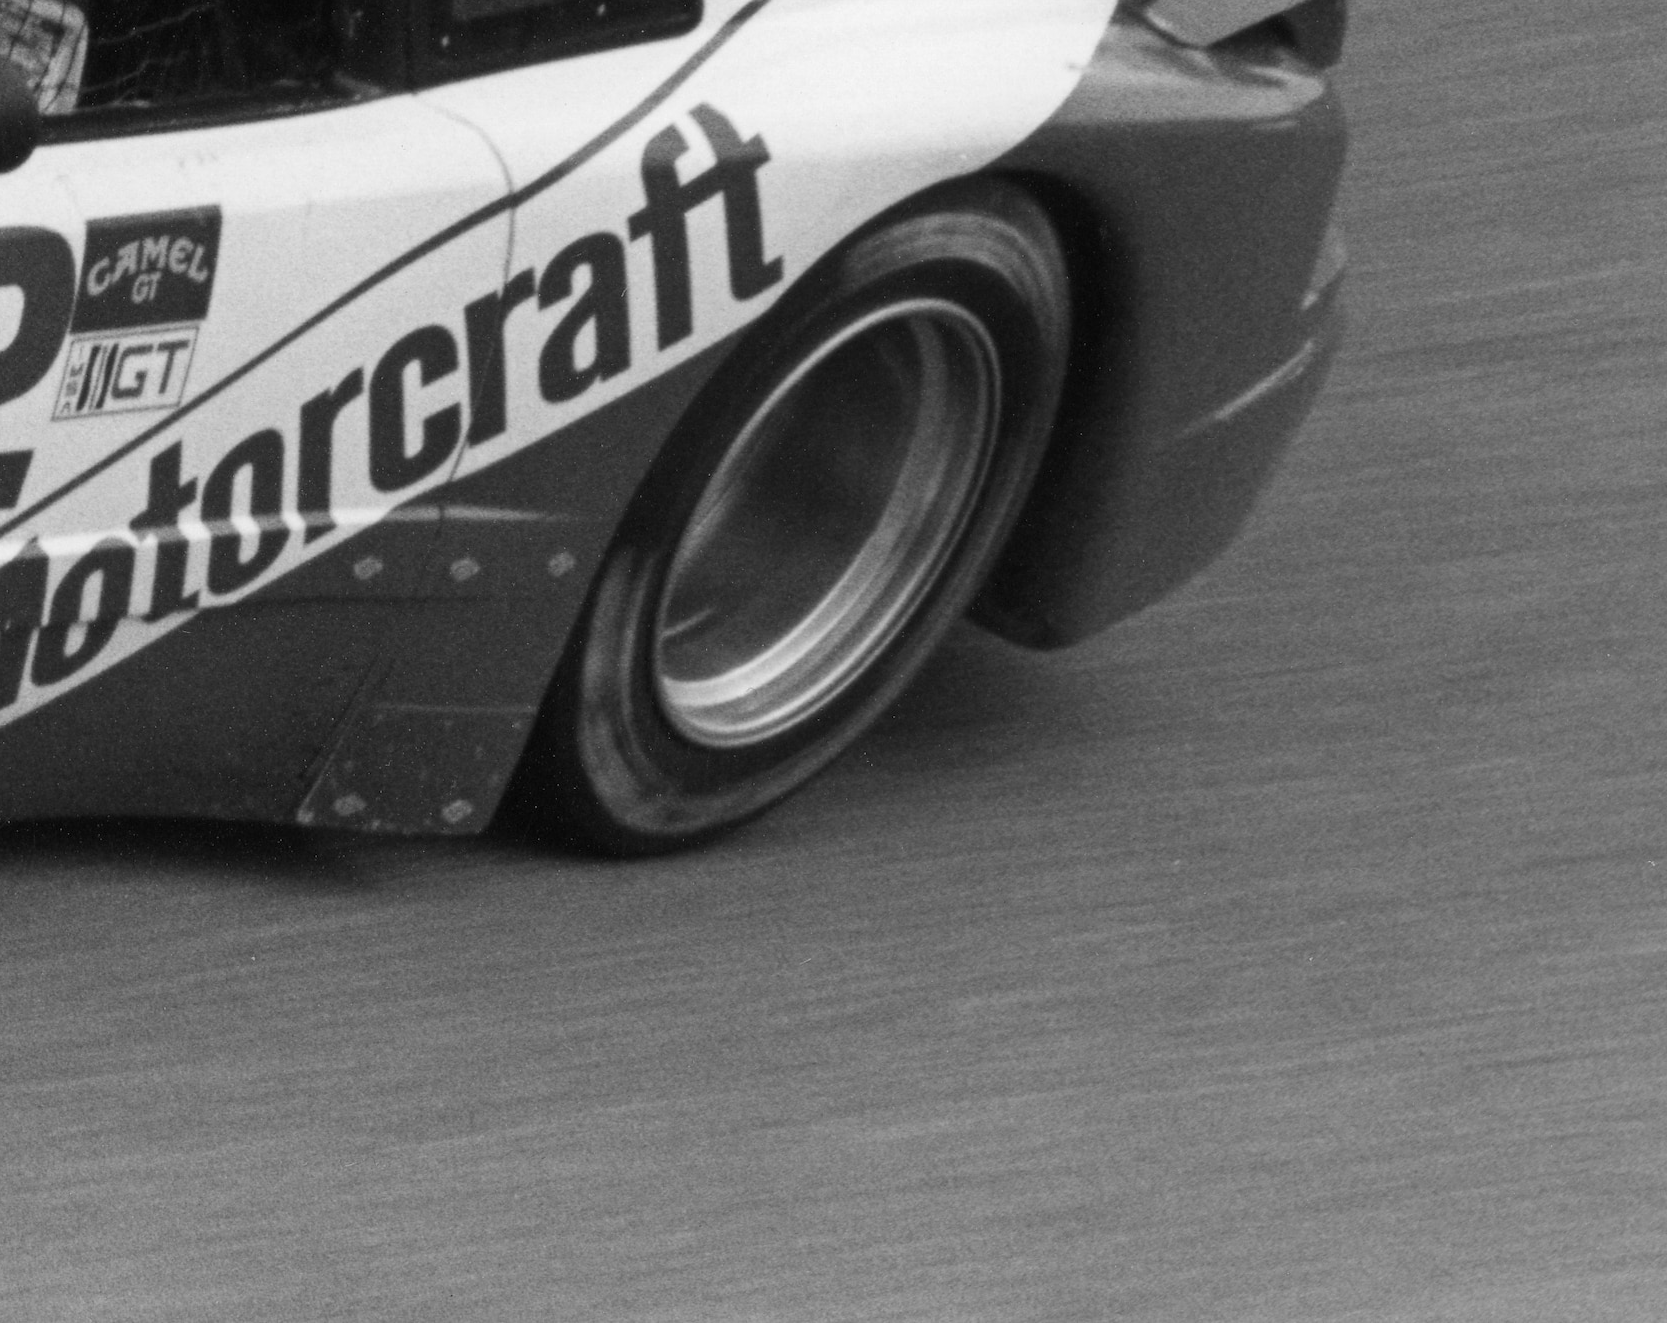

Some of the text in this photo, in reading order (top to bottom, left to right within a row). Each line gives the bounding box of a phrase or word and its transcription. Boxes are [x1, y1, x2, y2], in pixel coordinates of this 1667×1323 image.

[86, 235, 209, 298] CAMEL
[131, 271, 163, 305] GT
[111, 338, 190, 400] GT
